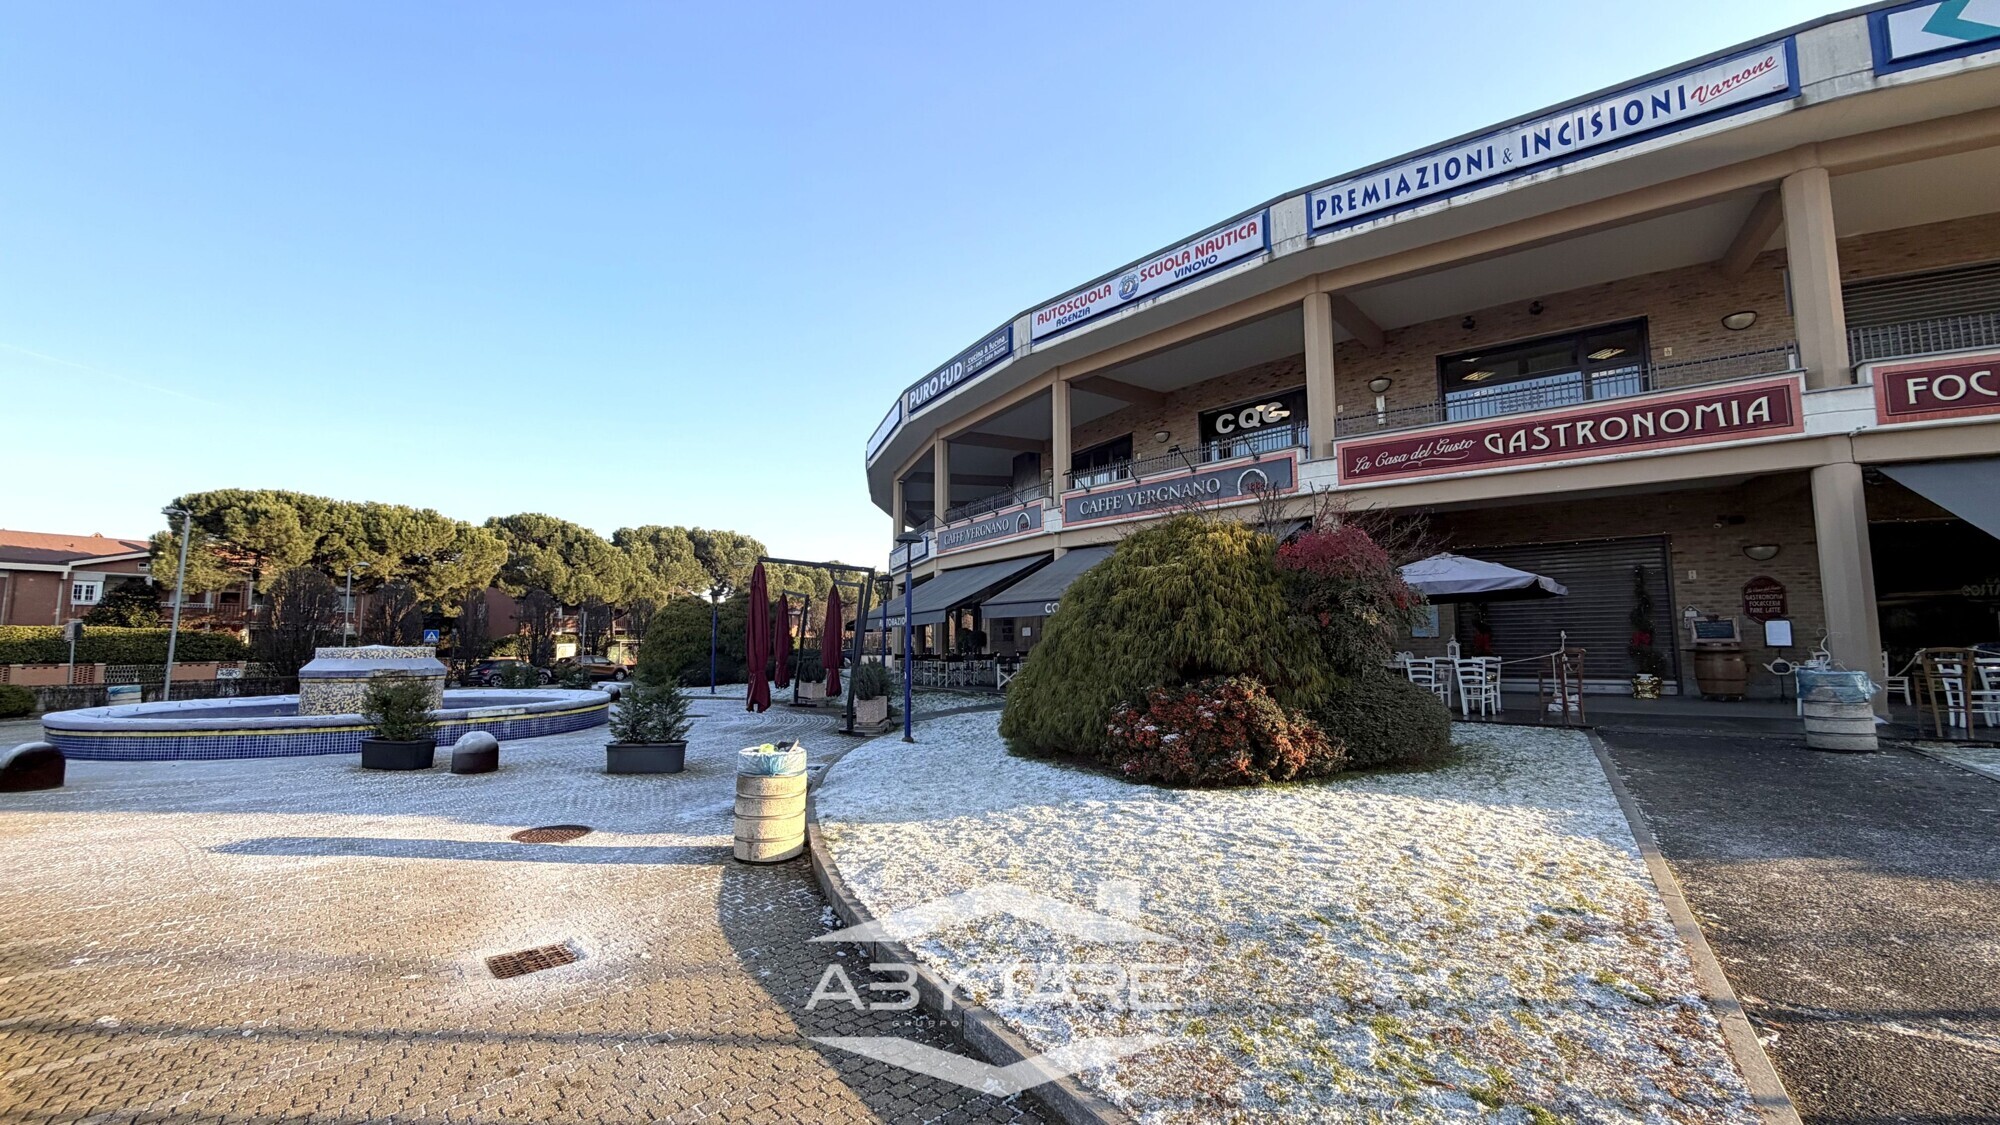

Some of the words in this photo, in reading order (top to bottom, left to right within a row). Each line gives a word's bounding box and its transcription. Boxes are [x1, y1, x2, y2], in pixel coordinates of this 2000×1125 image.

[1316, 145, 1494, 221] PREMIAZIONI
[1502, 147, 1514, 165] &
[1521, 84, 1687, 158] INCISIONI
[1690, 54, 1776, 104] Varrone
[1037, 284, 1112, 326] AUTOSCUOLA
[1140, 250, 1191, 283] SCUOLA
[1194, 221, 1258, 258] NAUTICA
[1056, 306, 1091, 327] AGENZIA
[1174, 254, 1218, 279] VINOVO
[909, 376, 939, 409] PURO
[940, 361, 963, 390] FUD
[1215, 401, 1284, 434] CQC
[1484, 396, 1771, 454] GASTRONOMIA
[1350, 455, 1371, 474] La
[1375, 450, 1409, 467] Casa
[1410, 444, 1431, 460] del
[1433, 438, 1477, 455] Gusto
[1127, 477, 1221, 507] VERGNANO
[965, 518, 1010, 540] VERGNANO
